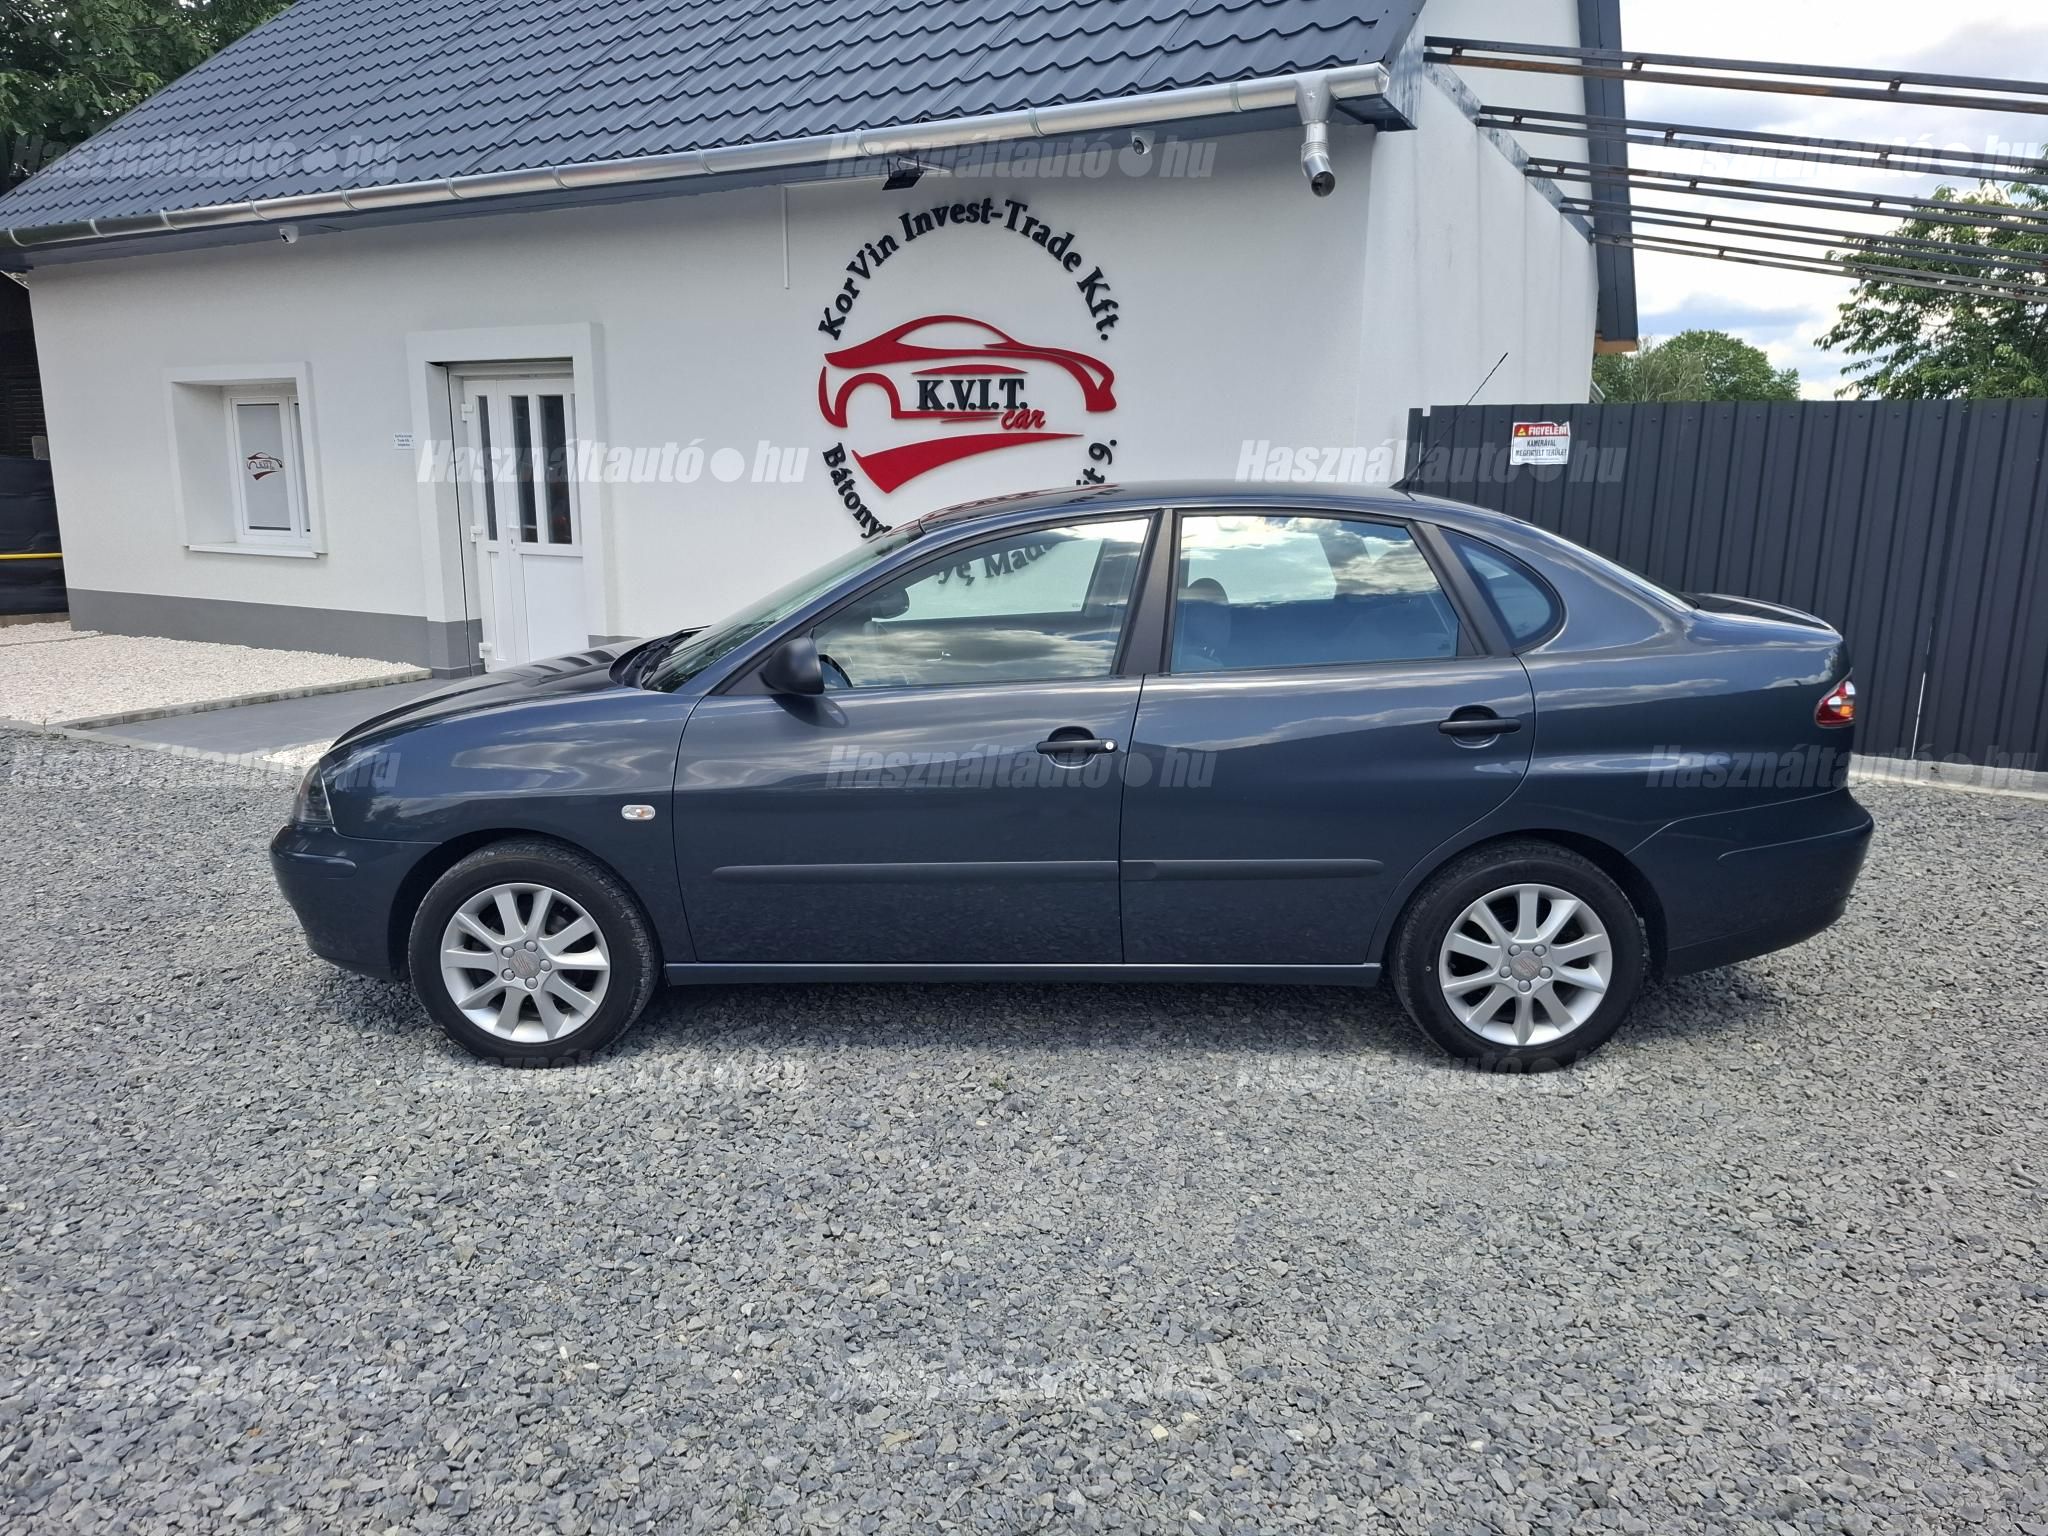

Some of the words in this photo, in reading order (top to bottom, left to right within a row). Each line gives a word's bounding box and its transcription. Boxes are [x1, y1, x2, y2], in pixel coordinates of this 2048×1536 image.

[818, 235, 900, 341] KorVin
[898, 198, 1082, 272] Invest-Trade
[1076, 266, 1119, 341] Kft.
[916, 379, 1028, 411] K.V.I.T.
[1000, 409, 1046, 430] car
[1088, 439, 1117, 465] 9.
